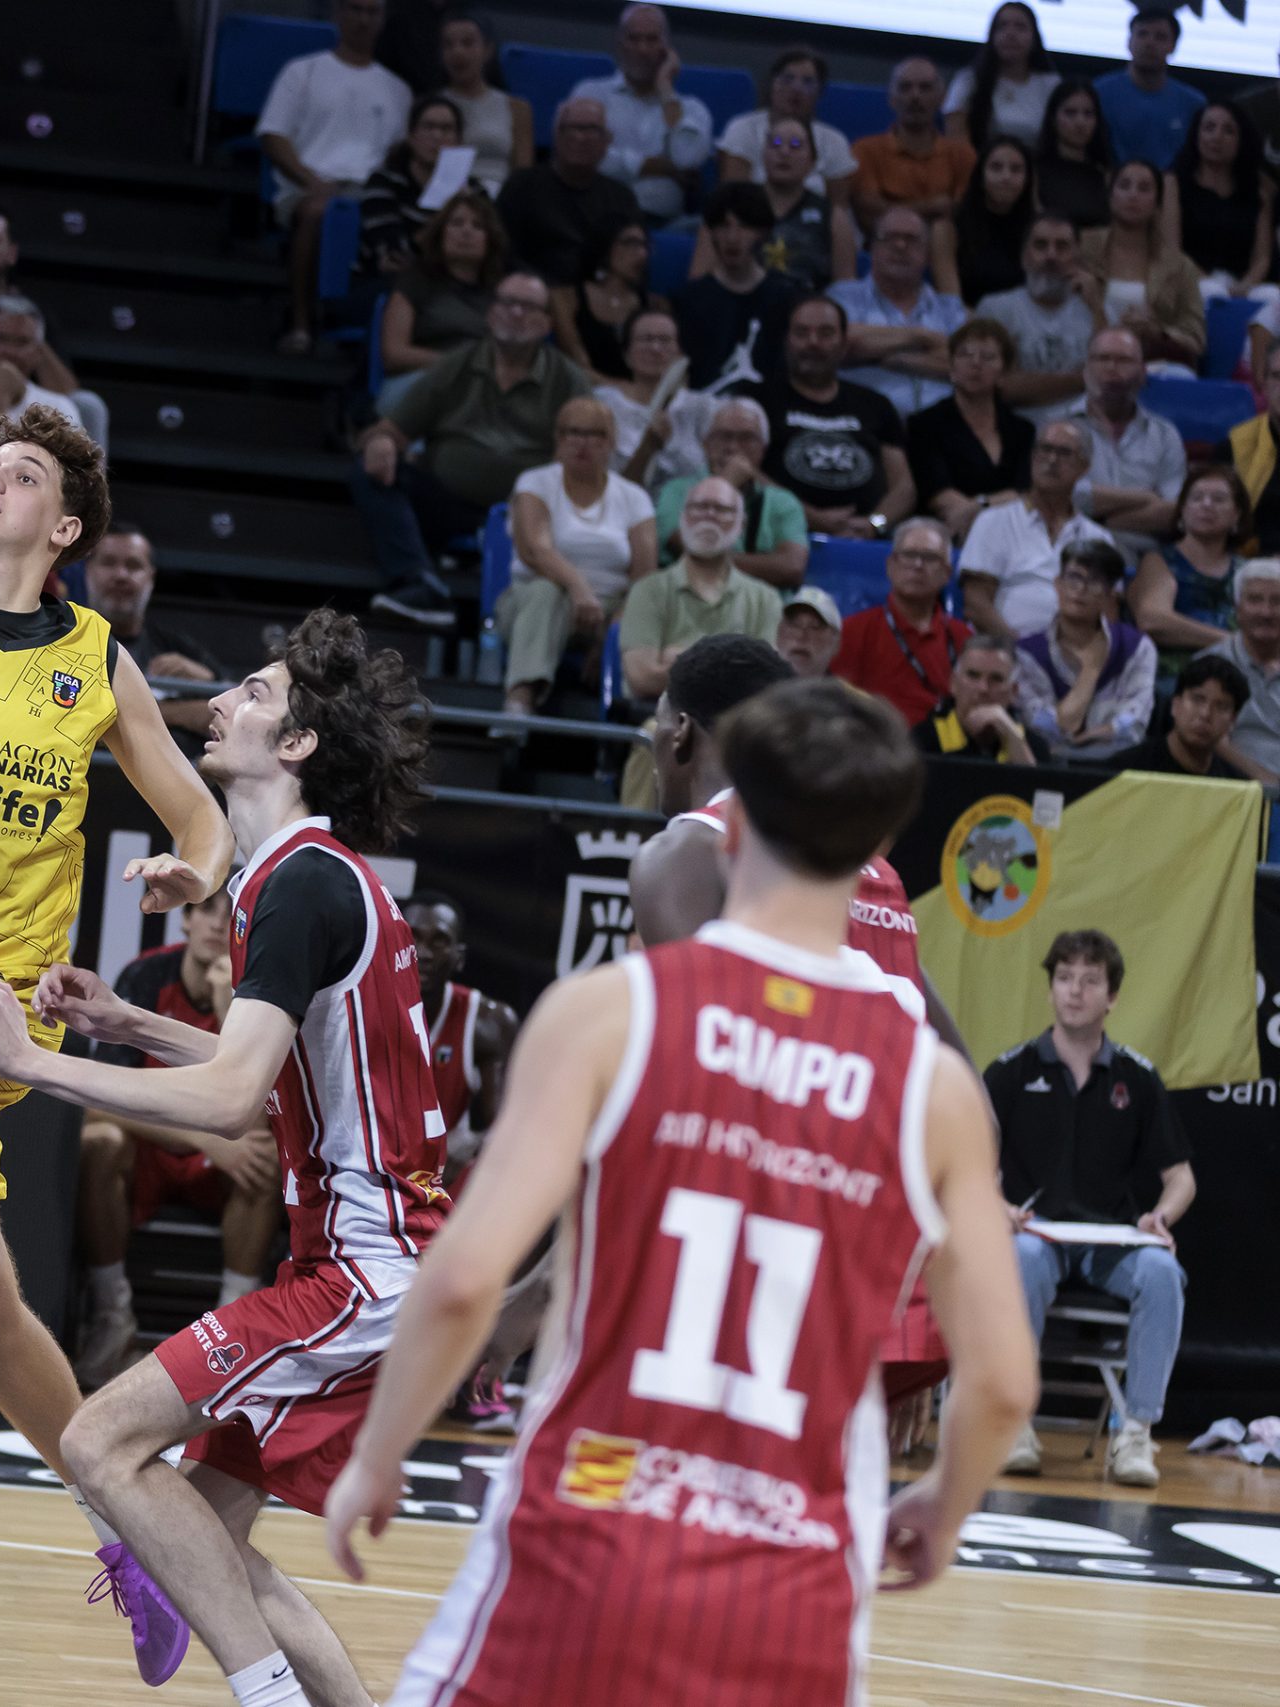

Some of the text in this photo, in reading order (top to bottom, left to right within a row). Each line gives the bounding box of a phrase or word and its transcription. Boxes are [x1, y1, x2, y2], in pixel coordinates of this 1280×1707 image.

[54, 672, 80, 689] LIGA
[849, 898, 918, 935] RIZONT
[695, 1004, 873, 1121] CAMPO
[630, 1187, 821, 1439] 11
